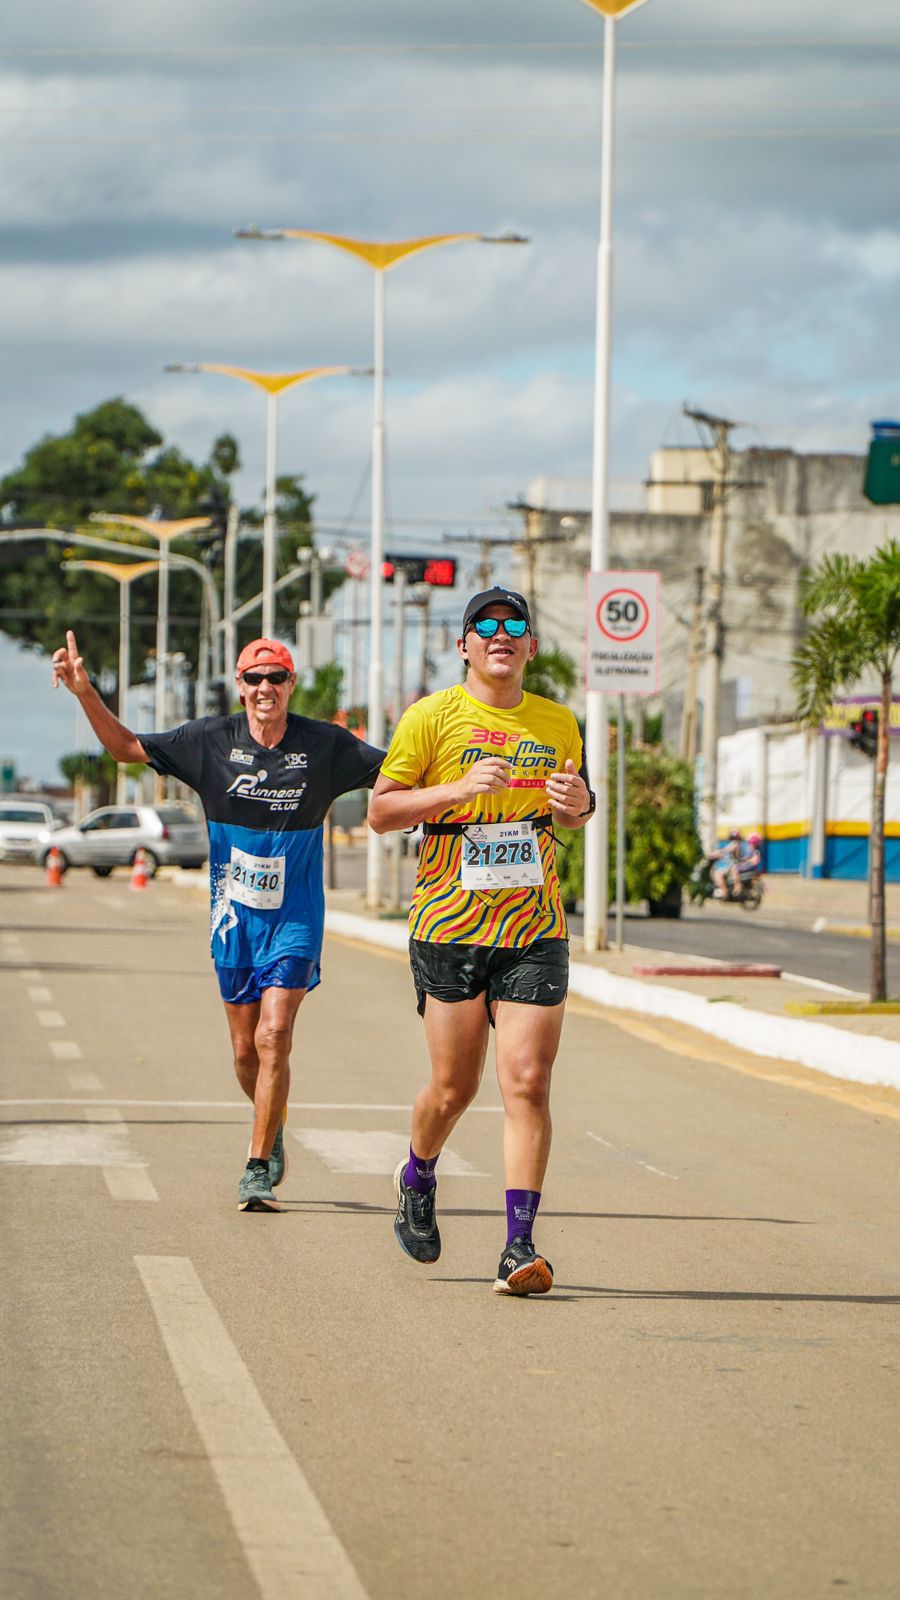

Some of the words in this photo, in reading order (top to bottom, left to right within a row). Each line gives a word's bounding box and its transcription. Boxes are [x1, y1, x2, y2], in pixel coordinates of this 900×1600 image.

[606, 599, 639, 622] 50
[517, 741, 556, 755] Meia
[270, 802, 299, 811] CLUB
[499, 830, 519, 838] 21KM
[467, 842, 532, 866] 21278
[233, 866, 279, 890] 21140
